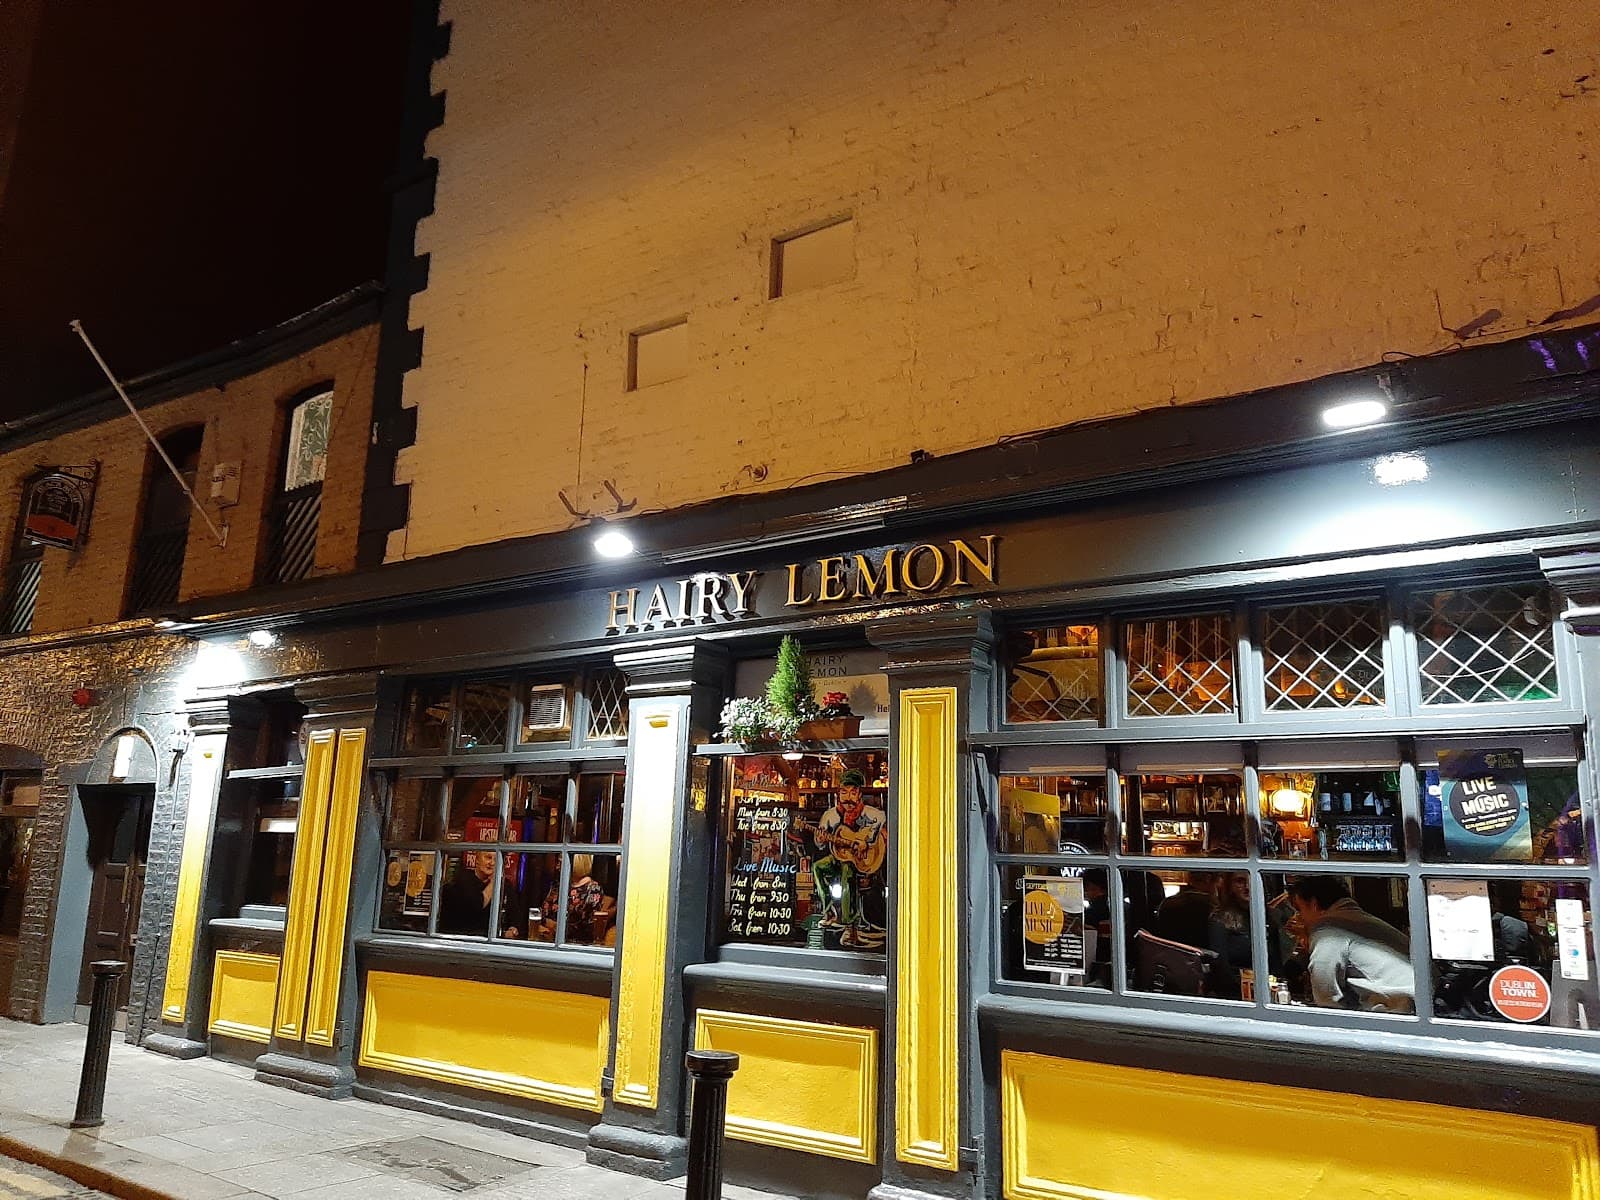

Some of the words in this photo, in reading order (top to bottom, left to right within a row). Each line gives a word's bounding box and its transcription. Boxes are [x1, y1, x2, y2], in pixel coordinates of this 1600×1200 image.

[606, 570, 758, 629] HAIRY
[784, 535, 996, 607] LEMON
[809, 666, 847, 677] EMON
[1461, 776, 1497, 796] LIVE
[1461, 793, 1509, 816] MUSIC
[735, 857, 758, 872] Live
[760, 857, 797, 874] Music
[731, 874, 748, 888] Wed
[730, 889, 746, 901] Thu
[729, 904, 743, 916] Fri
[1500, 979, 1536, 990] DUBLIN
[1501, 988, 1537, 998] TOWN
